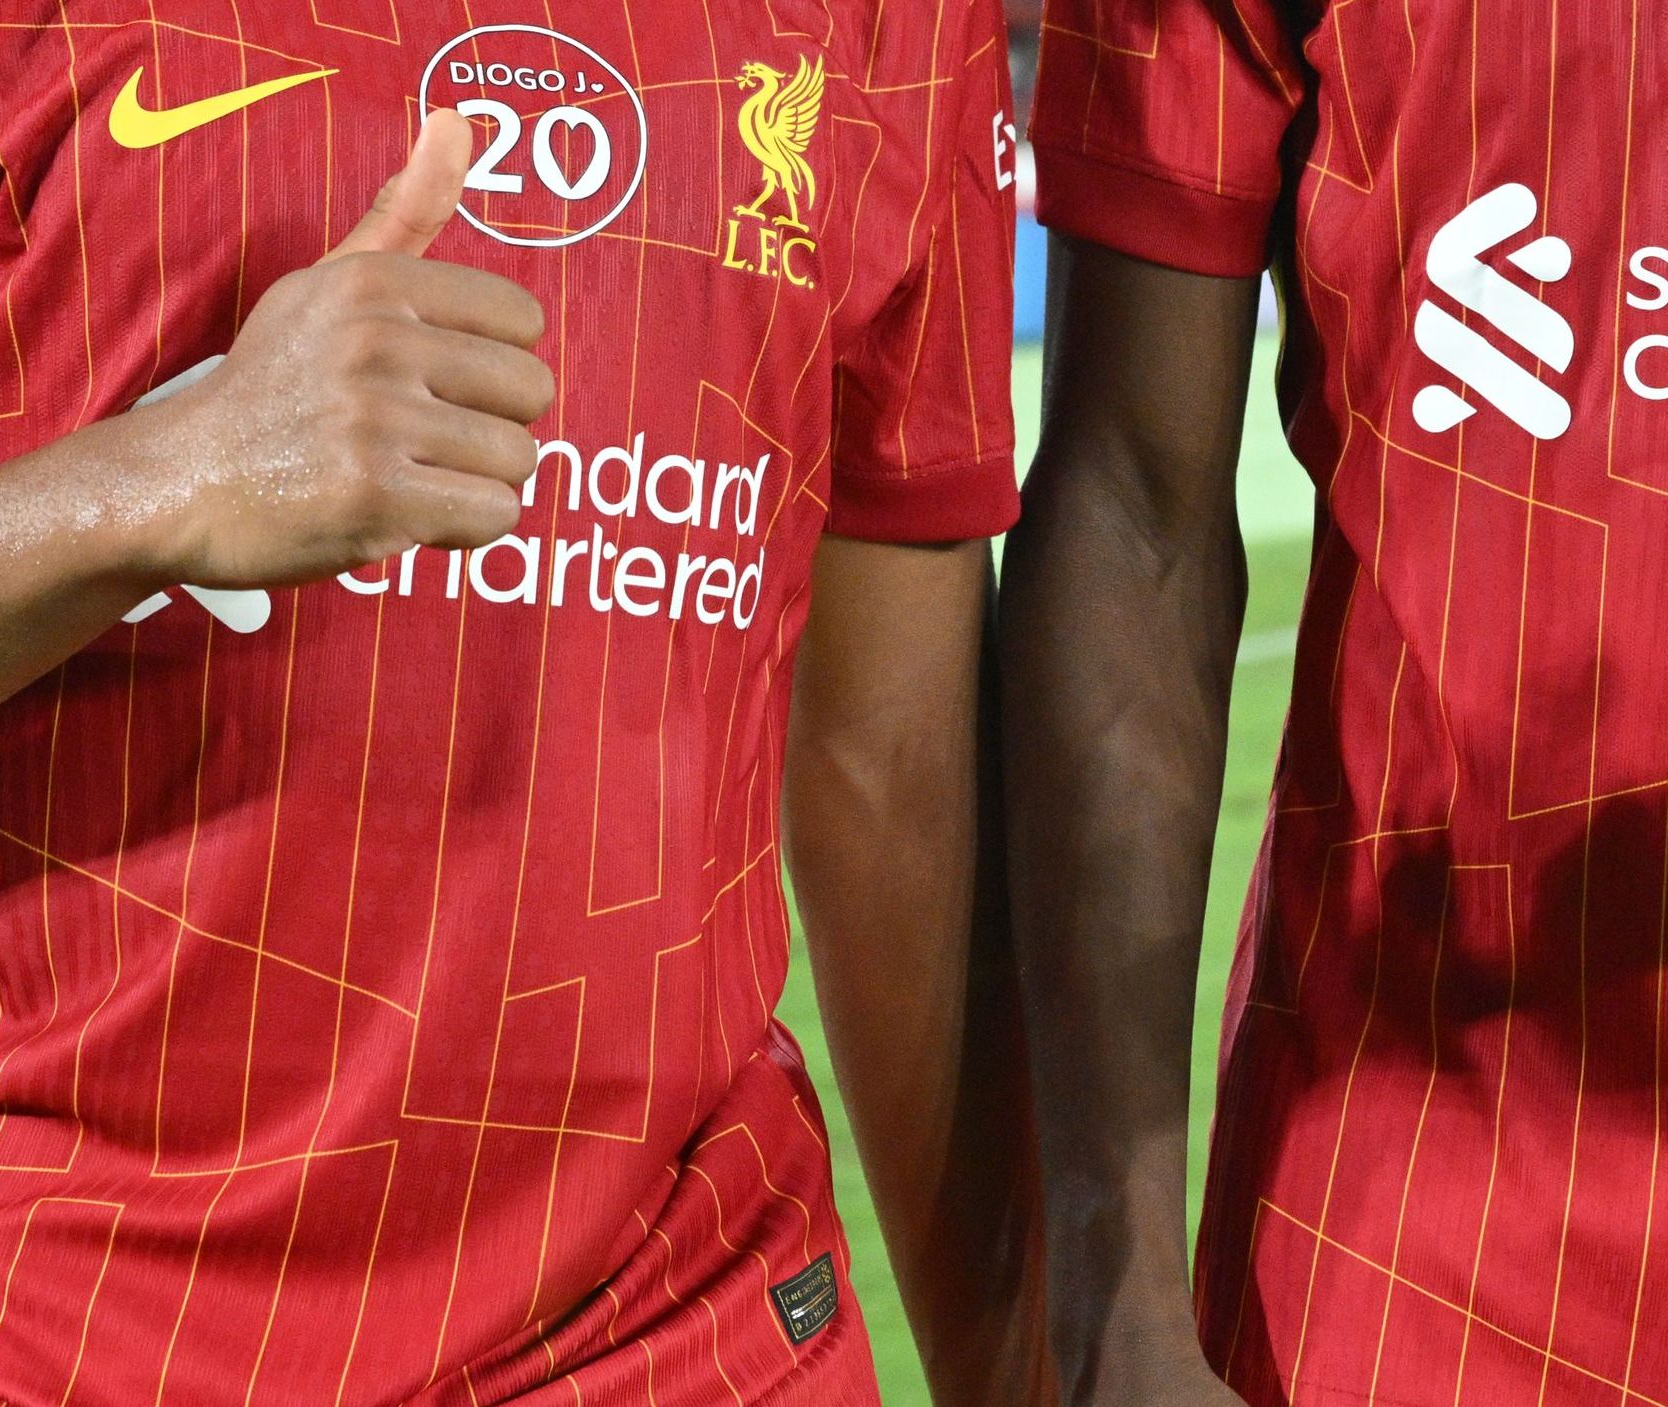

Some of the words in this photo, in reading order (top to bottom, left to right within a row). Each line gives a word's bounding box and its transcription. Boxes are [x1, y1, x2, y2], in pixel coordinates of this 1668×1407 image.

[449, 61, 567, 93] DIOGO
[456, 98, 612, 201] 20
[721, 218, 817, 290] L.F.C.
[521, 431, 772, 537] ndard
